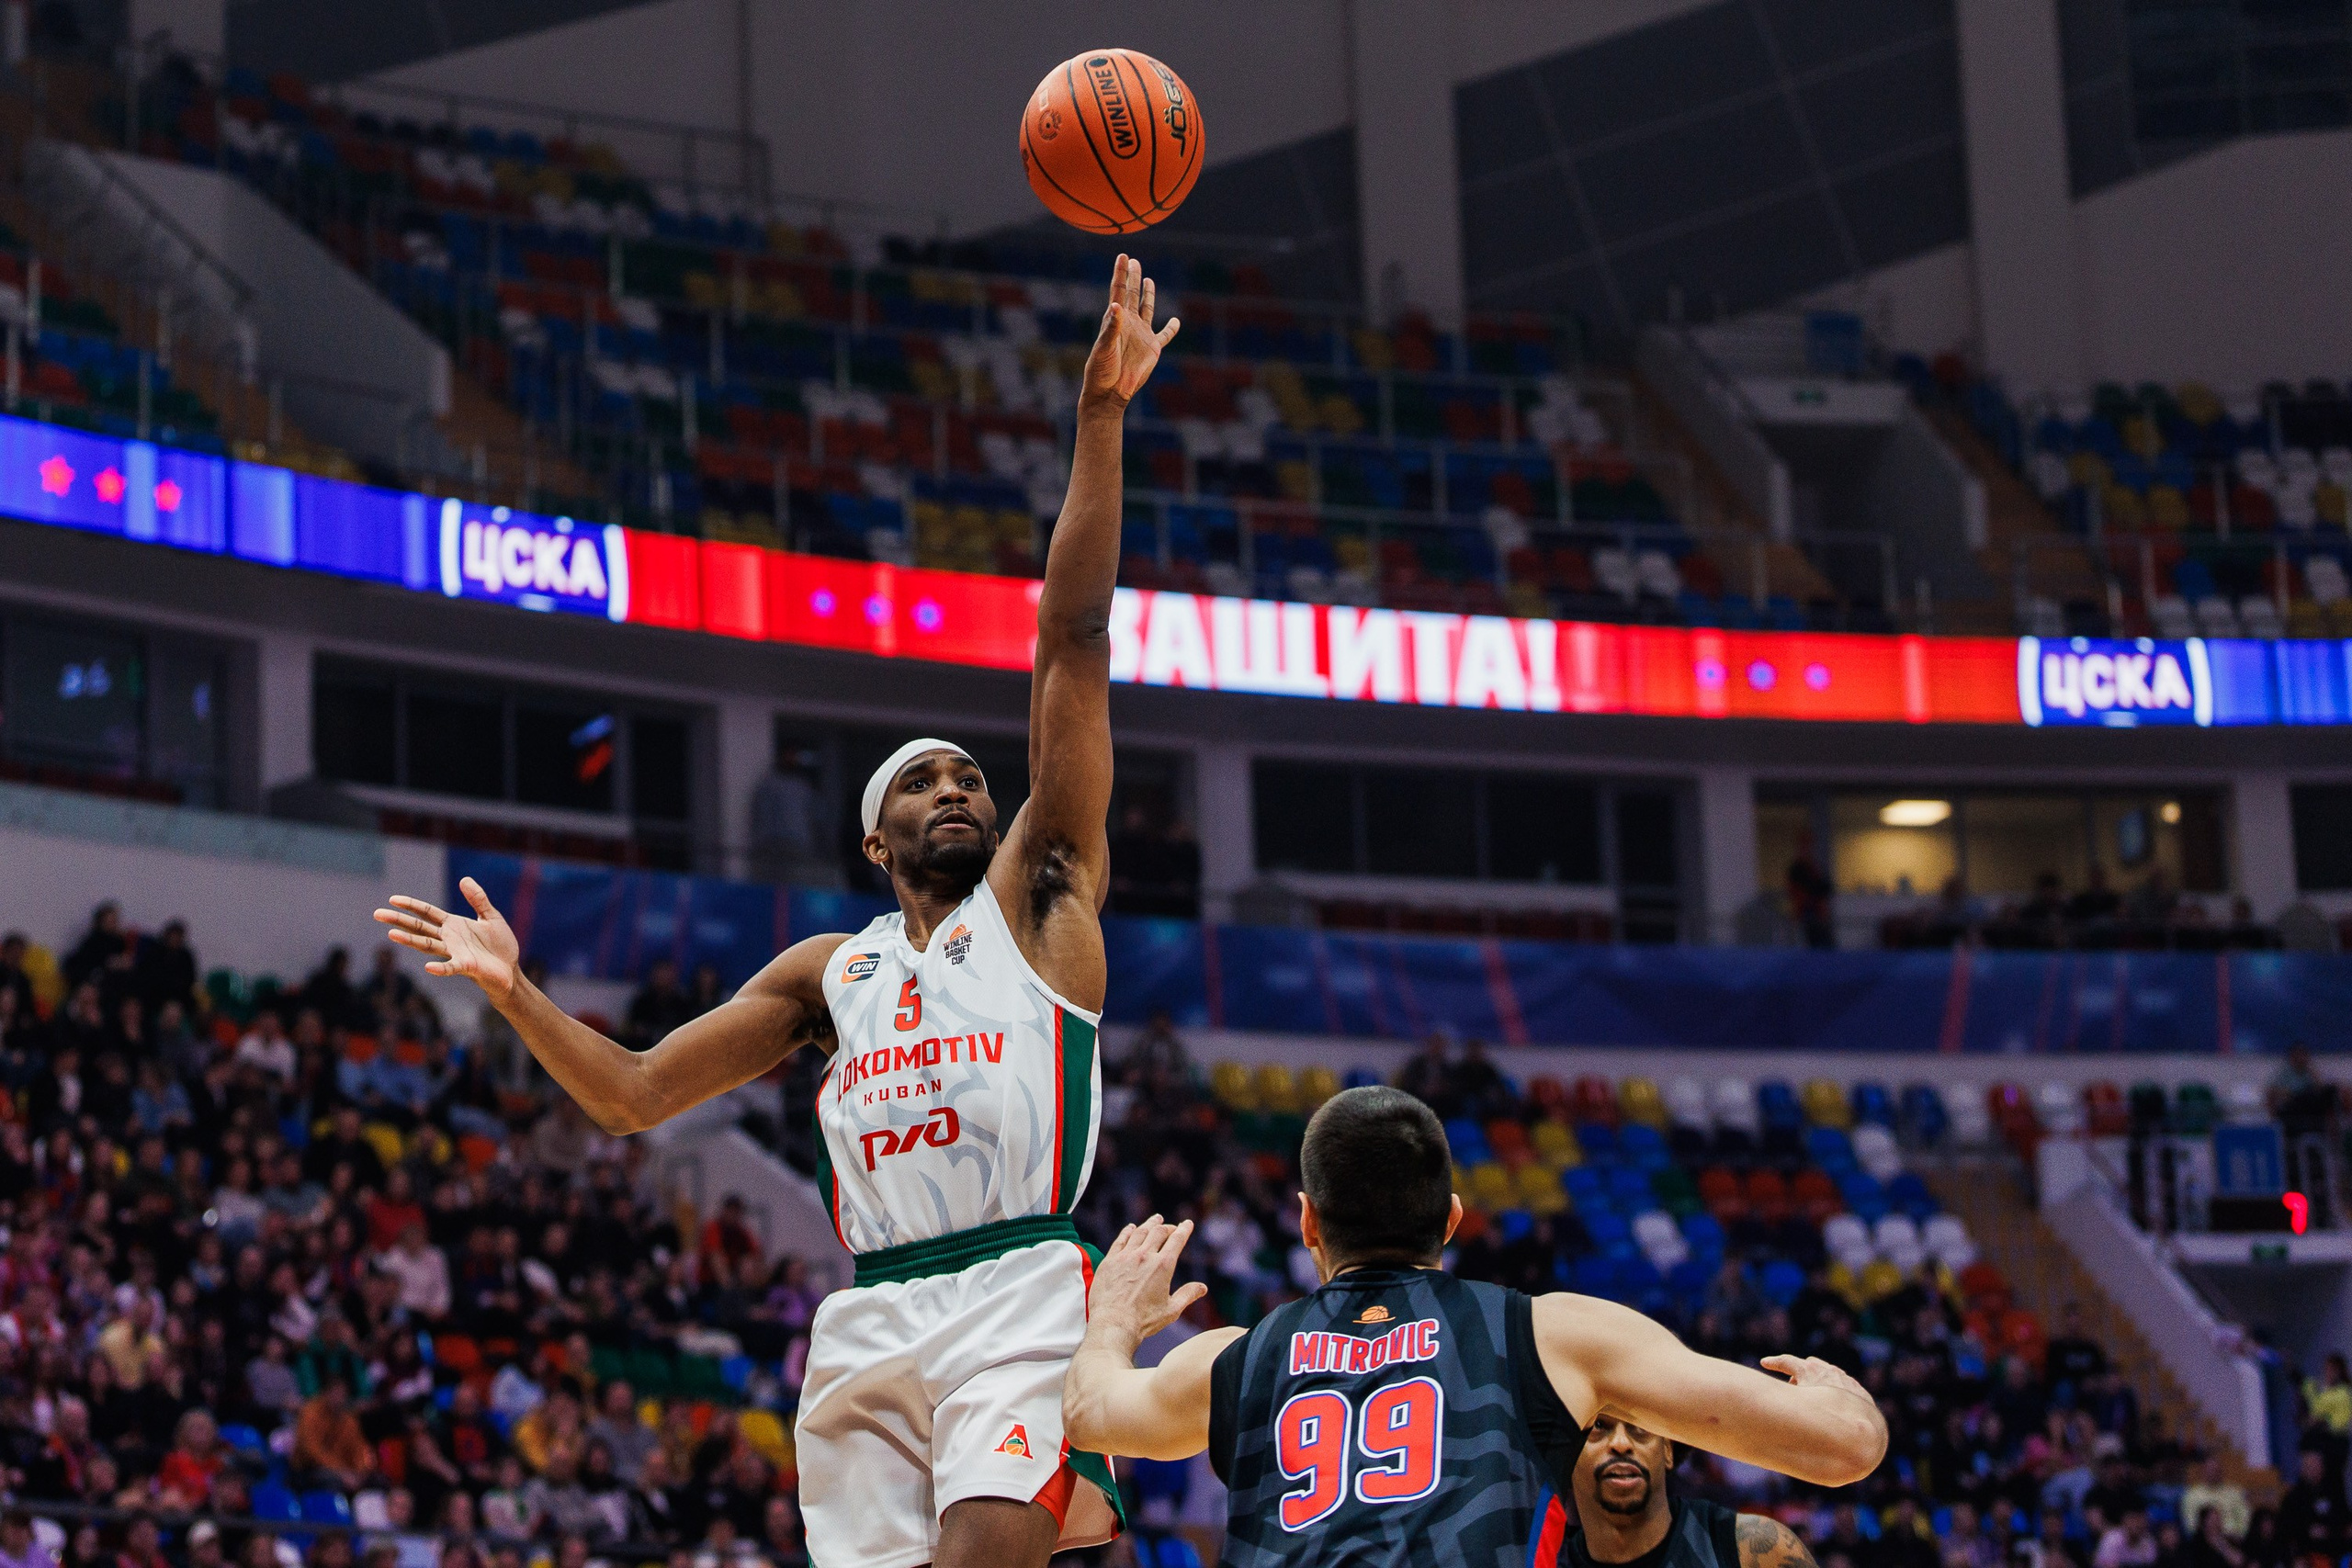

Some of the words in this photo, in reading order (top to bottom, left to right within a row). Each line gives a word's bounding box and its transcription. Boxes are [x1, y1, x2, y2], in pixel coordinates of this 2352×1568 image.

[1096, 69, 1134, 150] WINLINE
[462, 520, 608, 599] ЦСКА
[2041, 652, 2193, 718] ЦСКА
[851, 962, 876, 973] WIN
[944, 933, 973, 952] WINLINE
[945, 943, 971, 959] BASKET
[951, 954, 966, 965] CUP
[894, 973, 922, 1032] 5
[837, 1032, 1004, 1105] LOKOMOTIV
[864, 1078, 943, 1107] KUBAN
[1289, 1318, 1440, 1375] MITROVIC
[1274, 1376, 1444, 1532] 99
